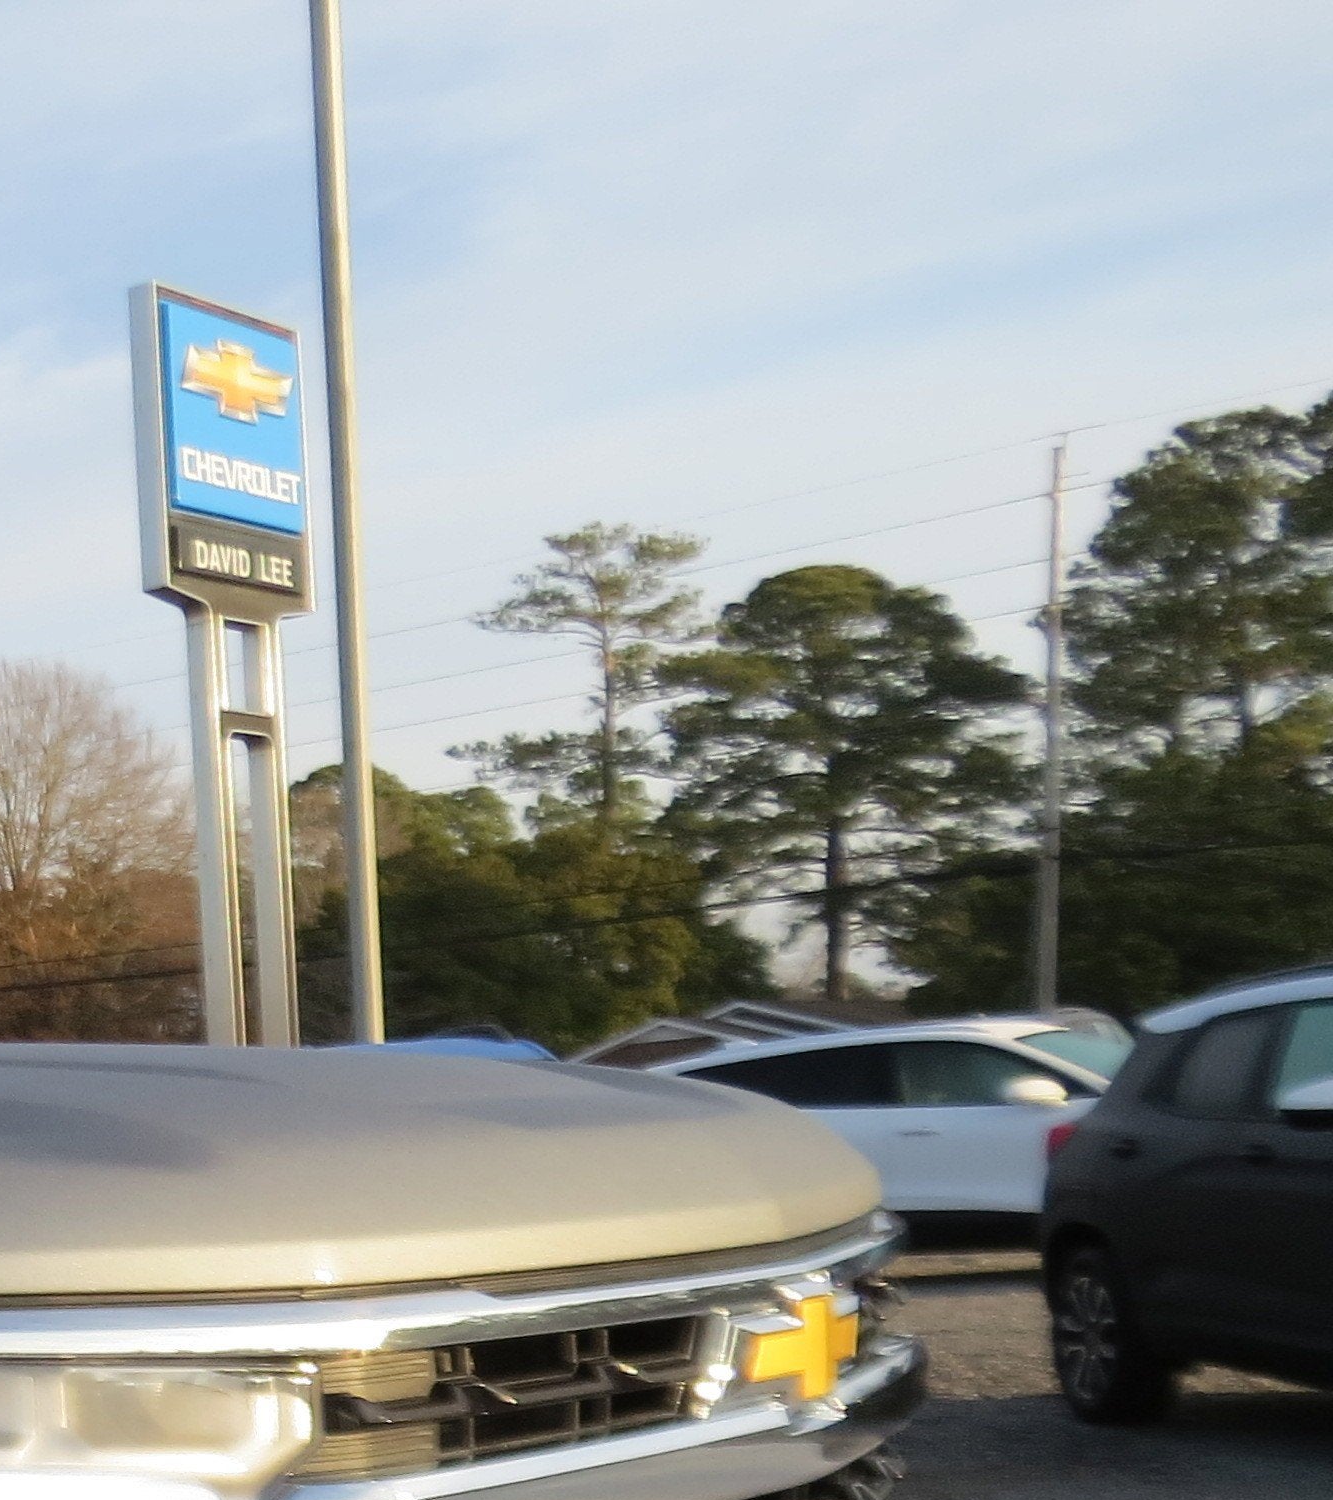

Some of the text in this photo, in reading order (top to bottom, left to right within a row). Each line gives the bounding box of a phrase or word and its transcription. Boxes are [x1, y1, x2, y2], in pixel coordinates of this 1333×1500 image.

[182, 447, 300, 505] CHEVROLET
[195, 539, 295, 588] DAVID LEE
